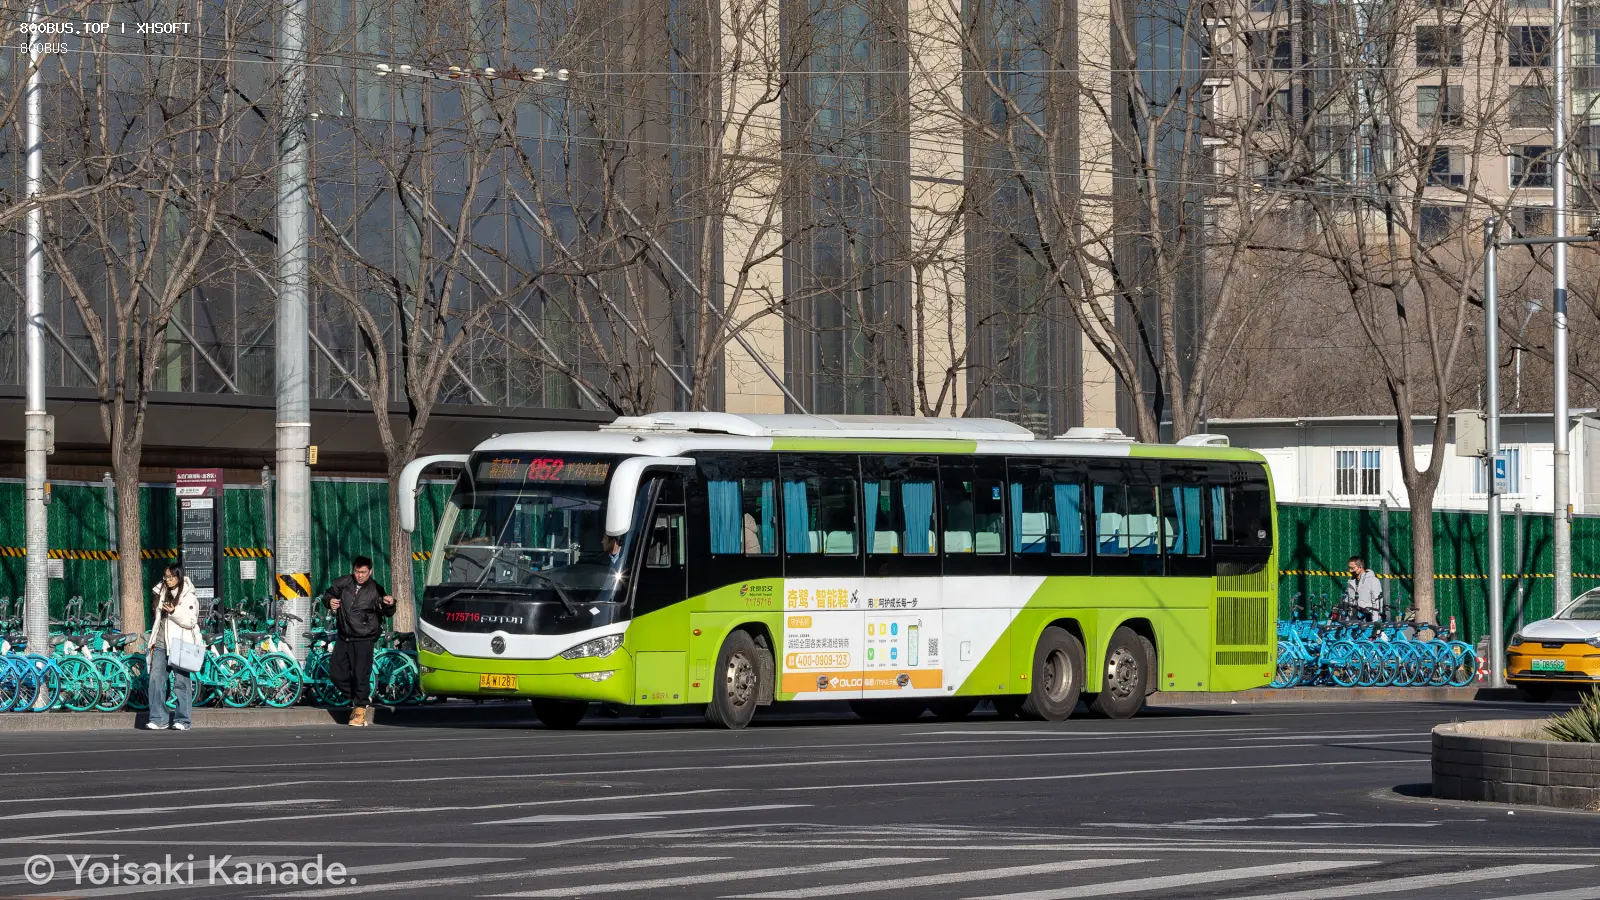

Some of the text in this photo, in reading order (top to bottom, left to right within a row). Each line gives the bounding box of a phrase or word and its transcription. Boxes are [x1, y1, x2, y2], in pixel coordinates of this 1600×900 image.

[528, 459, 564, 480] 852
[744, 597, 772, 607] 7175716
[446, 612, 480, 622] 7175716
[480, 614, 523, 624] FOTON
[798, 654, 848, 667] 400-0909-123
